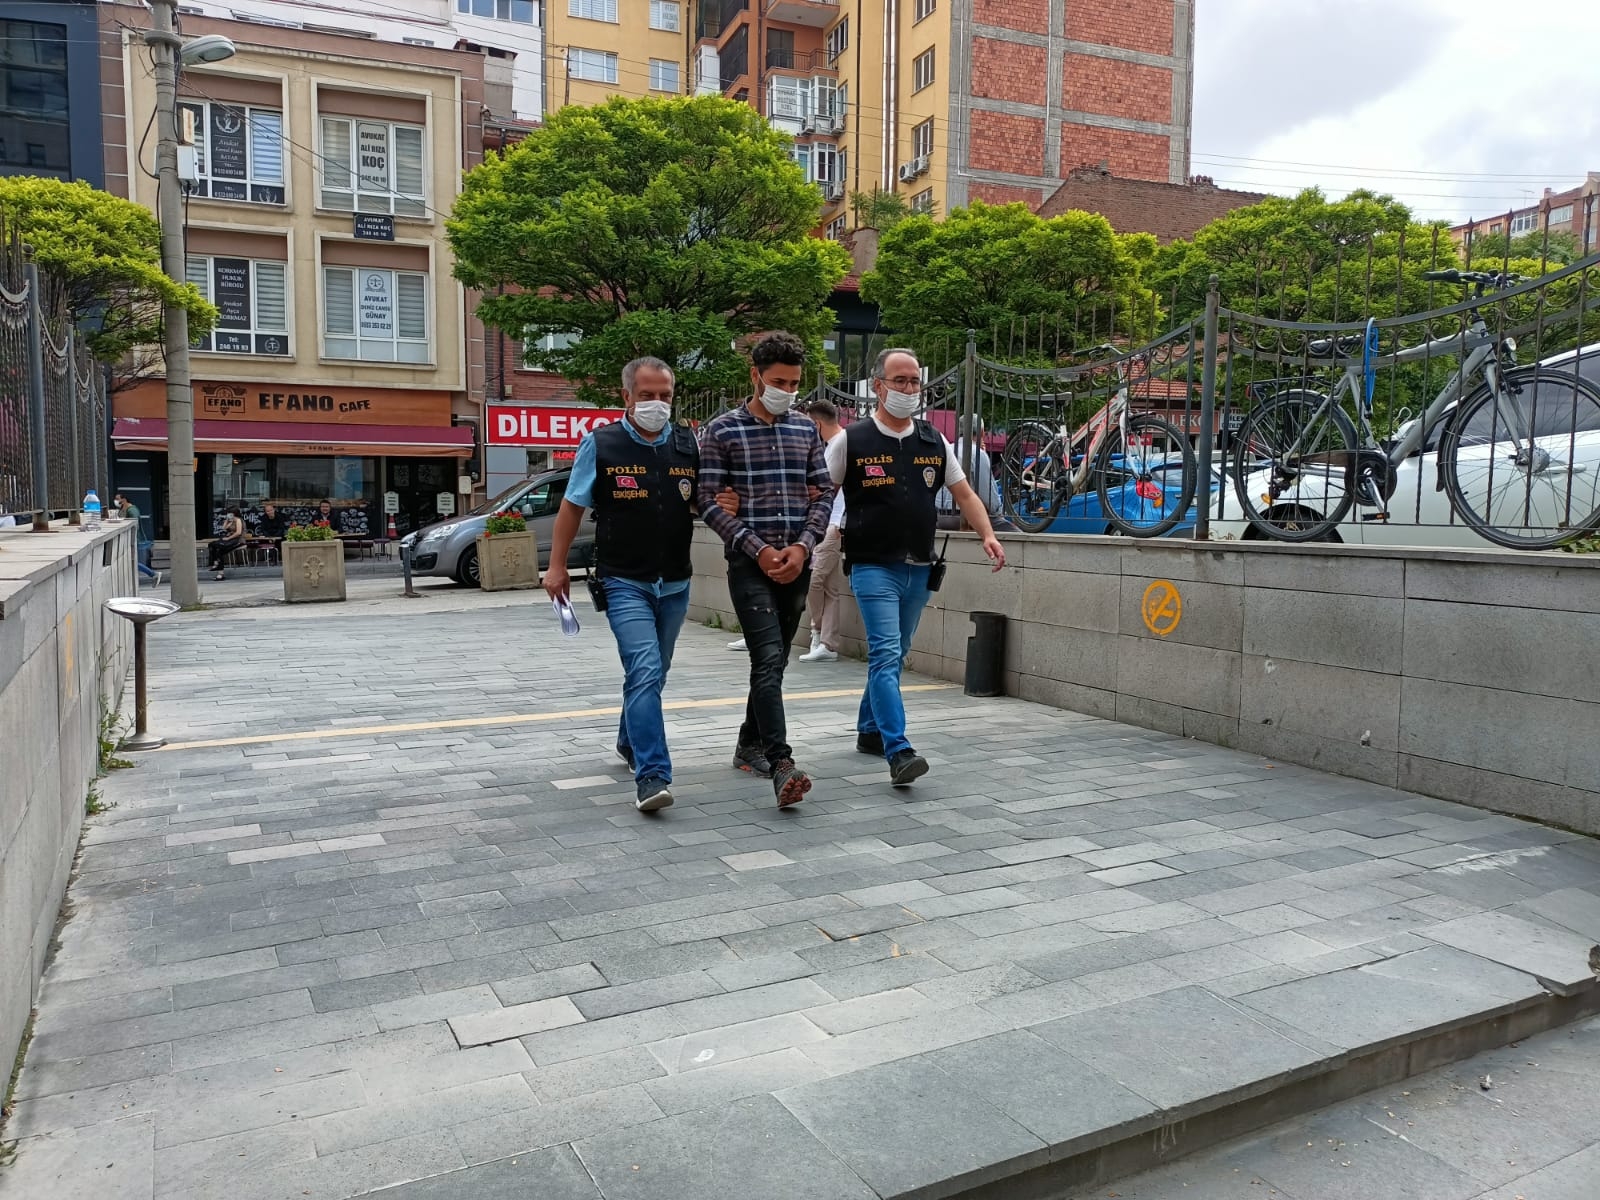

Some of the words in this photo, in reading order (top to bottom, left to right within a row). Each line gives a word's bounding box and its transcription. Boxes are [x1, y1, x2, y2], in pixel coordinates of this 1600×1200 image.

[360, 132, 385, 140] AVUKAT
[360, 144, 370, 152] ALİ
[362, 155, 384, 170] KOÇ
[366, 311, 386, 319] GÜNAY
[208, 398, 242, 407] EFANO
[258, 393, 334, 412] EFANO
[339, 400, 371, 412] CAFE
[498, 410, 621, 438] DİLEK
[856, 454, 893, 466] POLİS
[913, 456, 942, 466] ASAYİŞ
[606, 465, 647, 475] POLİS
[669, 466, 695, 478] ASAYİŞ
[862, 476, 896, 487] ESKİŞEHİR
[612, 488, 648, 500] ESKİŞEHİR
